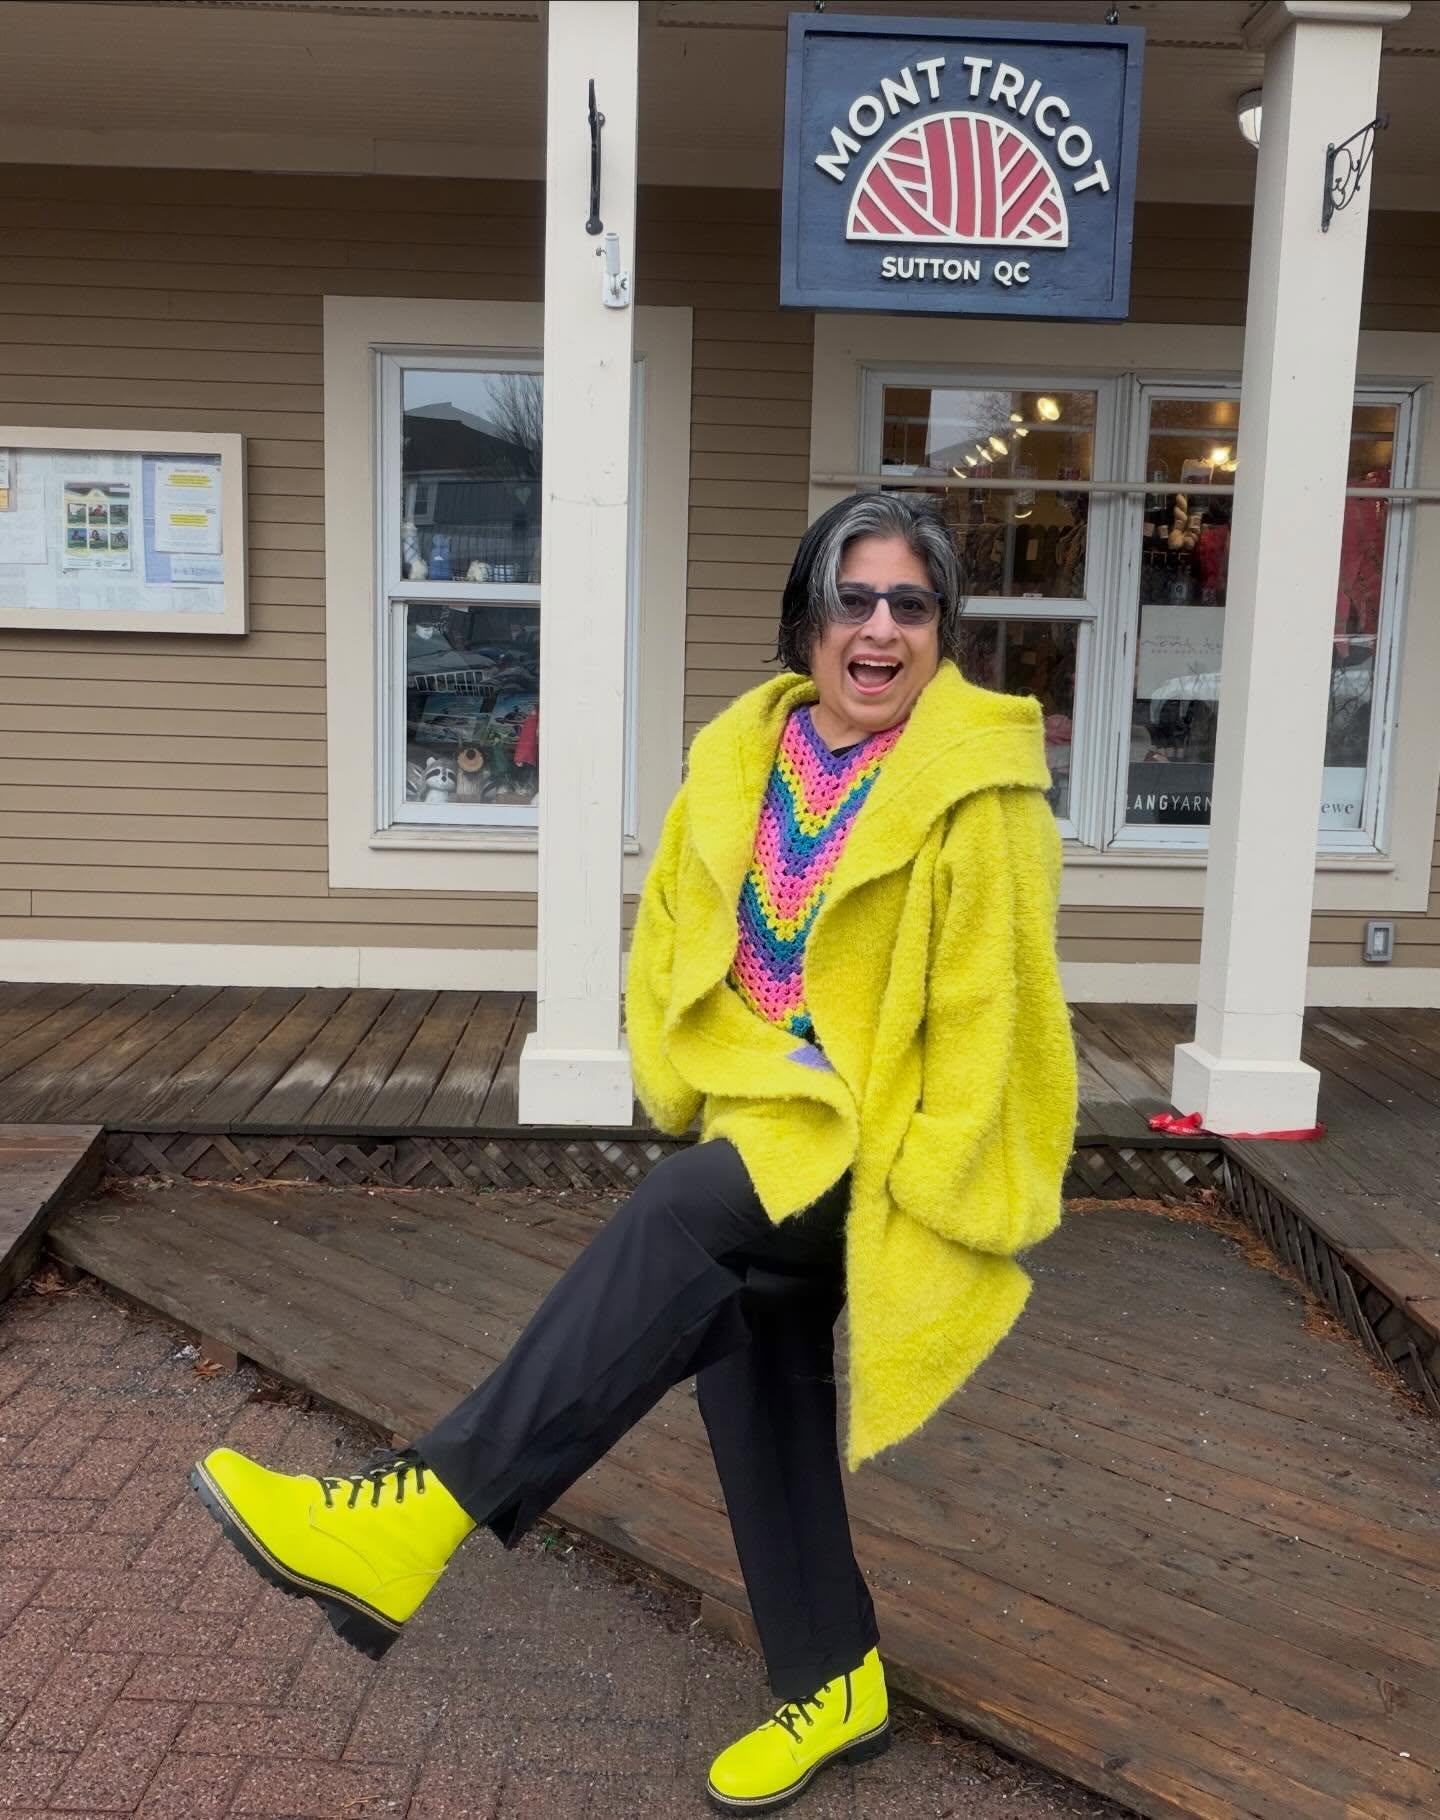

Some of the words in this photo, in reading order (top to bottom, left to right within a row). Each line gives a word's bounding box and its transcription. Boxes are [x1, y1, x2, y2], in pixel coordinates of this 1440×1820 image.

[814, 56, 946, 182] MONT
[963, 55, 1111, 194] TRICOT
[881, 256, 981, 281] SUTTON
[993, 260, 1031, 286] QC
